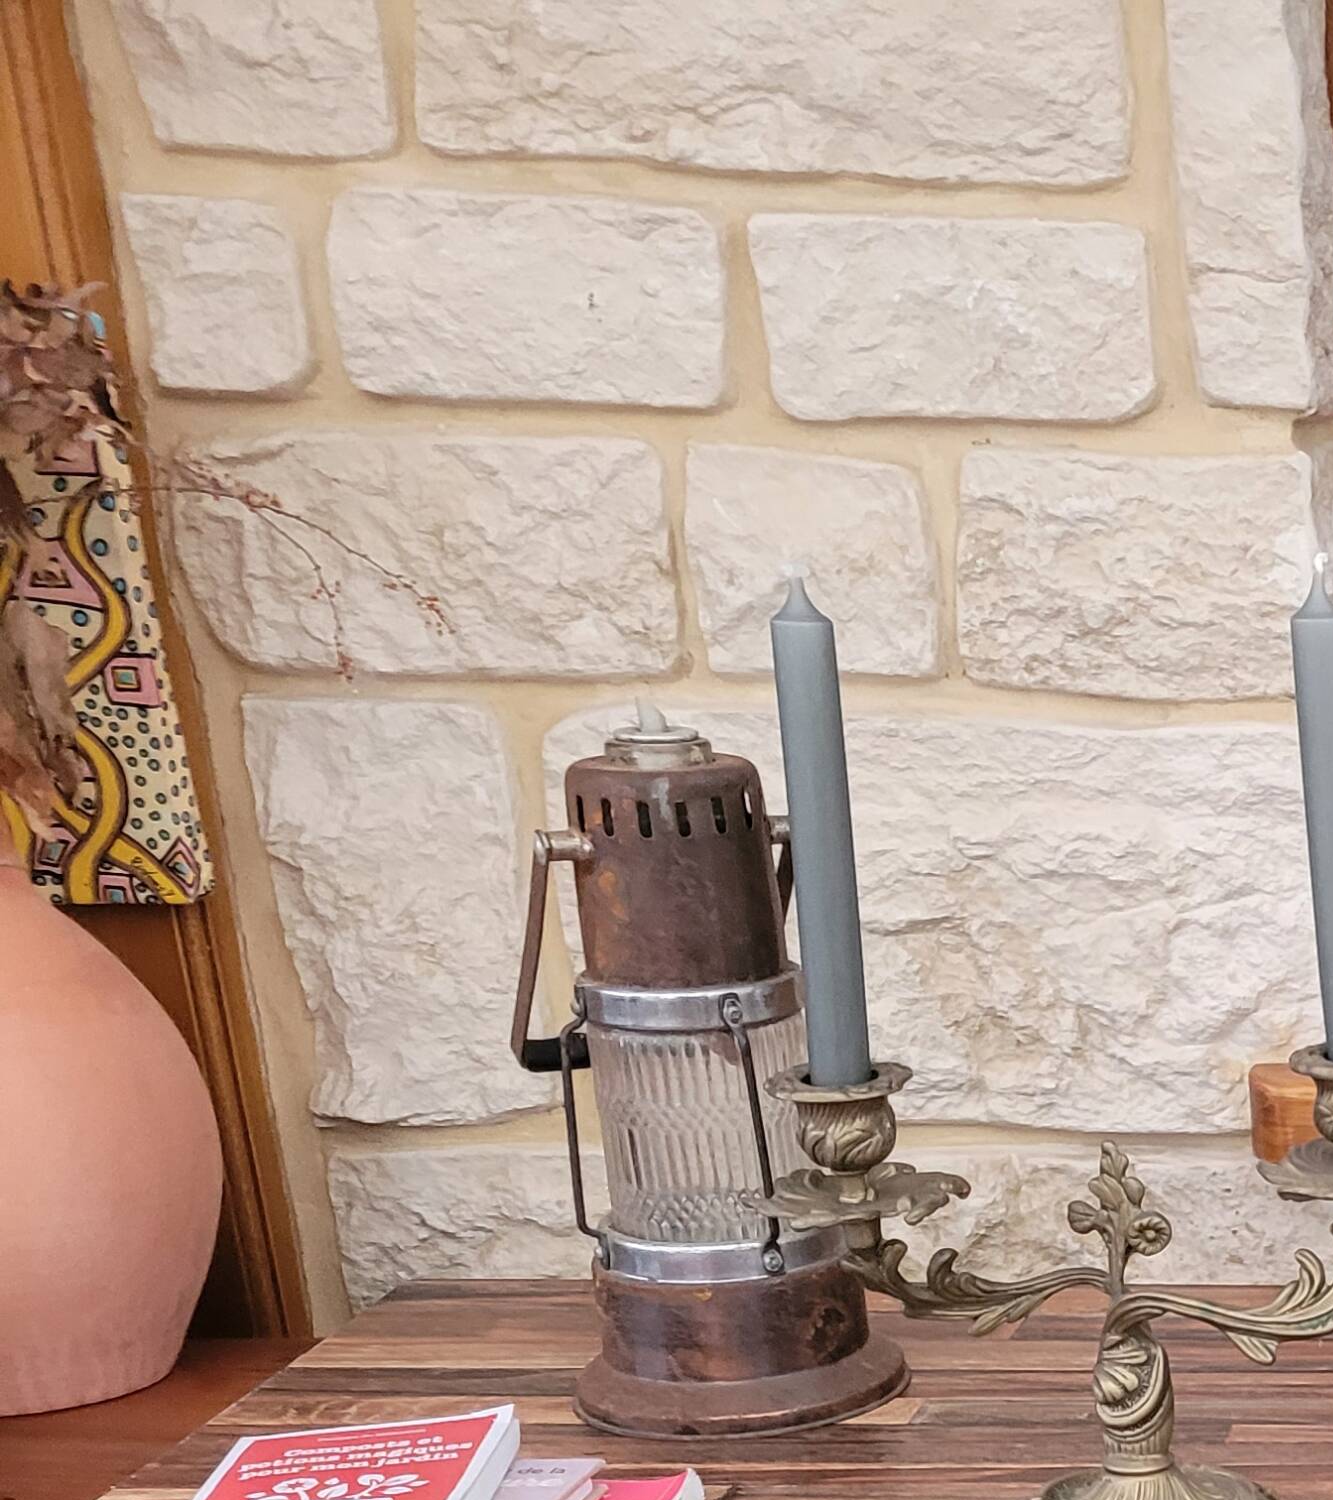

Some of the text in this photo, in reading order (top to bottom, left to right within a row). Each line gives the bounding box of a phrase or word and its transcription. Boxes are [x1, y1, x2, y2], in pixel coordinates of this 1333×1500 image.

[237, 1441, 473, 1473] potions magiques
[283, 1441, 411, 1457] Composts
[416, 1435, 444, 1446] et
[238, 1452, 459, 1481] pour mon jardin
